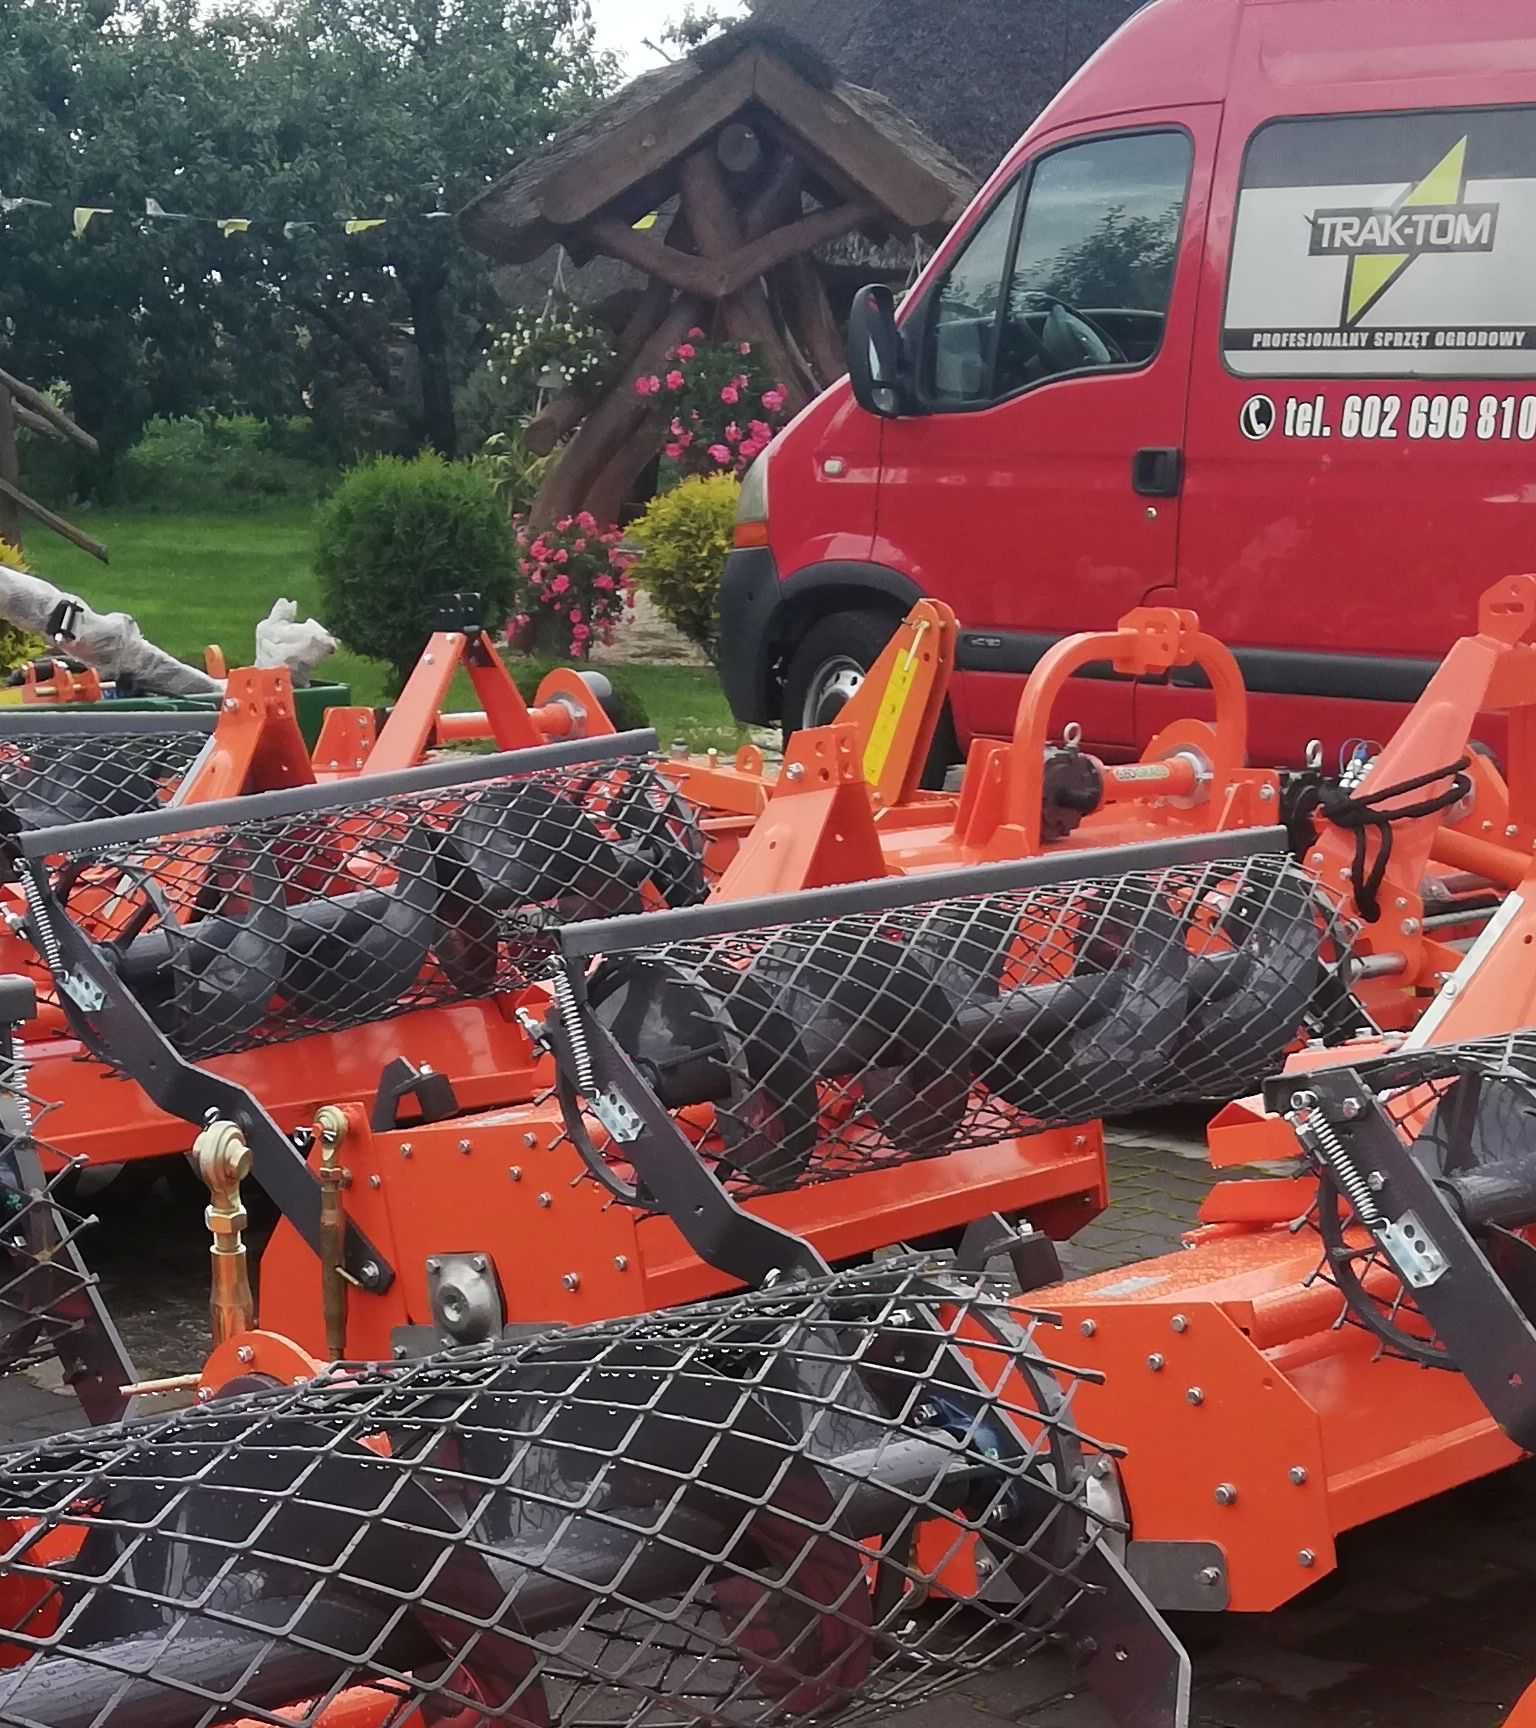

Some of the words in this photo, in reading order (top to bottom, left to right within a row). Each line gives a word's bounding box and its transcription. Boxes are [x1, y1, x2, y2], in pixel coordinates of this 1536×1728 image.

[1317, 212, 1491, 248] TRAK-TOM
[1252, 332, 1369, 348] PROFESJONALNY
[1373, 331, 1430, 348] SPRZĘT
[1434, 331, 1526, 347] OGRODOWY
[1284, 395, 1331, 437] tel.
[1340, 394, 1402, 439] 602
[1408, 394, 1470, 440] 696
